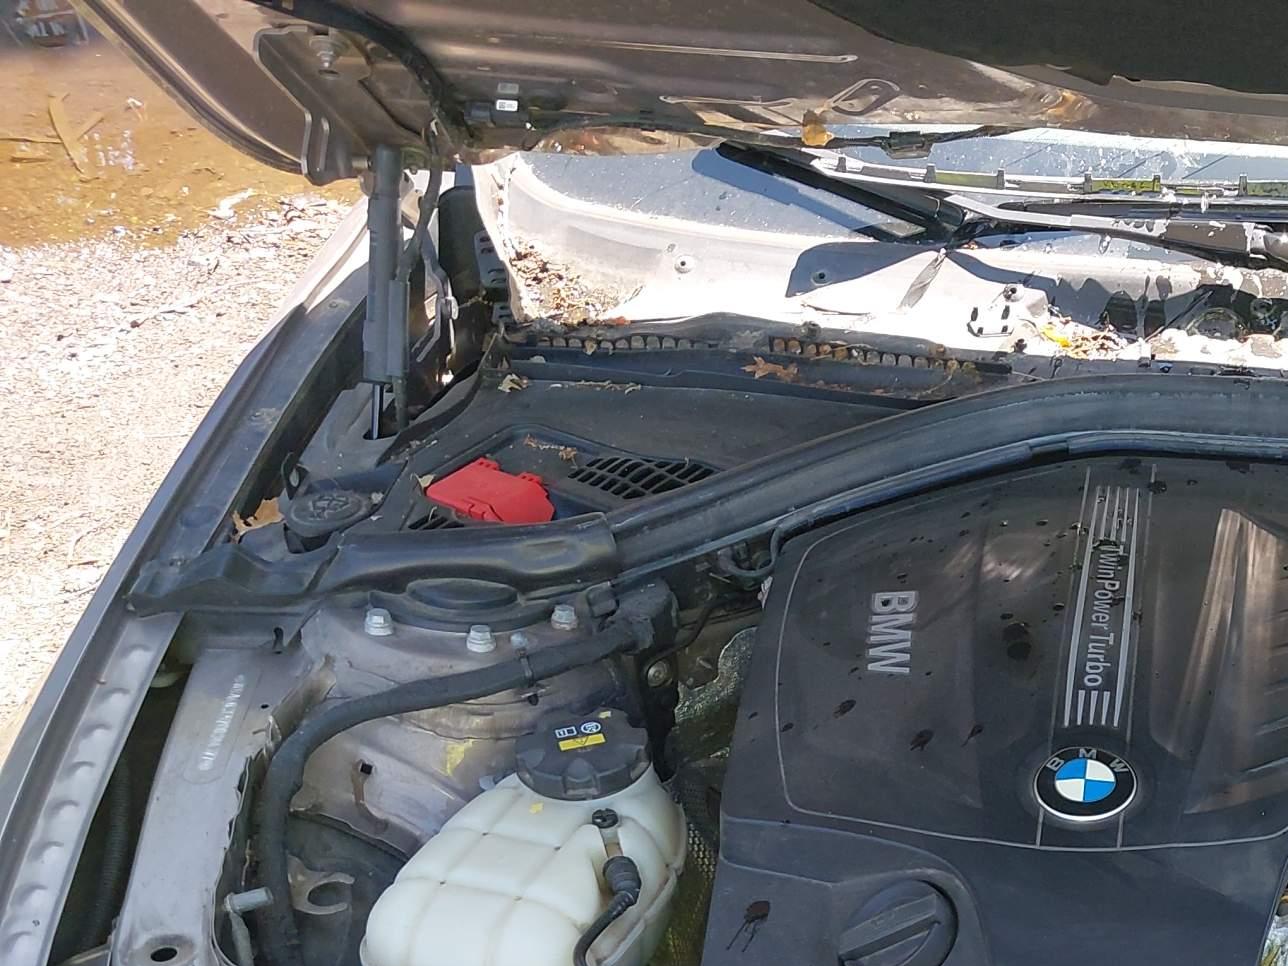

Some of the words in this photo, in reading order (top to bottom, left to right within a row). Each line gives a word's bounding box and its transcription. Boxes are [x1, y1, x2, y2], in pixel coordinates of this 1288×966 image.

[1090, 544, 1125, 631] TwinPower
[867, 590, 919, 674] BMW
[1083, 632, 1115, 687] Turbo
[1046, 747, 1129, 775] BMW
